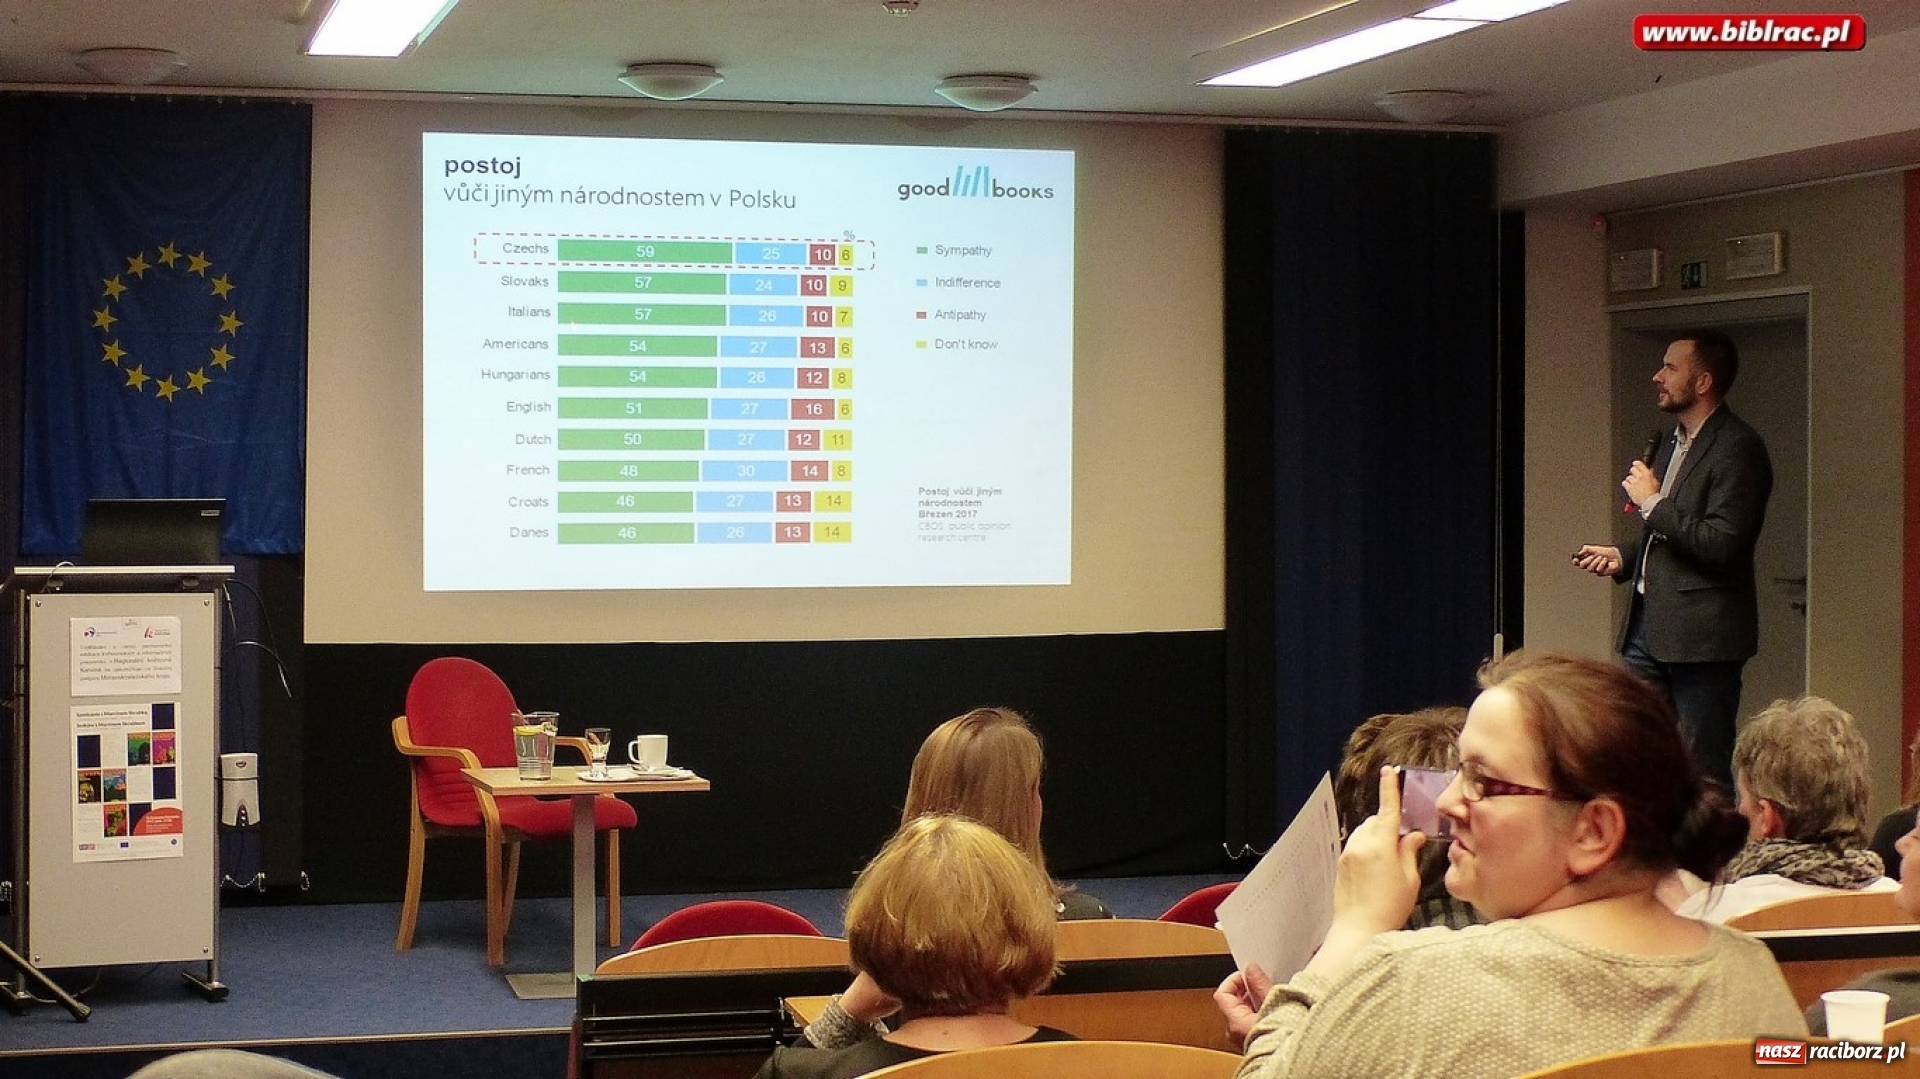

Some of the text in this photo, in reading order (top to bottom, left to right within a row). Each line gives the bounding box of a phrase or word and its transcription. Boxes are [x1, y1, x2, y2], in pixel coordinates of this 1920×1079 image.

[445, 157, 520, 179] postoj
[444, 182, 796, 208] vůči jiným národnostem v Polsku
[898, 177, 1053, 200] good books
[503, 243, 851, 262] Czechs 59 25 10 6
[936, 244, 992, 257] Sympathy
[502, 275, 847, 293] Slovaks 57 24 10 9
[936, 277, 1001, 288] Indifference
[509, 306, 849, 324] Italians 57 26 10 7
[935, 309, 986, 322] Antipathy
[483, 339, 850, 355] Americans 54 27 13 6
[935, 339, 999, 350] Don't know
[482, 369, 847, 386] Hungarians 54 26 12 8
[507, 401, 850, 417] English 51 27 16 6
[516, 432, 844, 448] Dutch 50 27 12 11
[507, 464, 846, 478] French 48 30 14 8
[919, 487, 949, 496] Postoj
[509, 493, 843, 508] Croats 46 27 13 14
[956, 510, 977, 518] 2017
[510, 526, 840, 540] Danes 46 26 13 14
